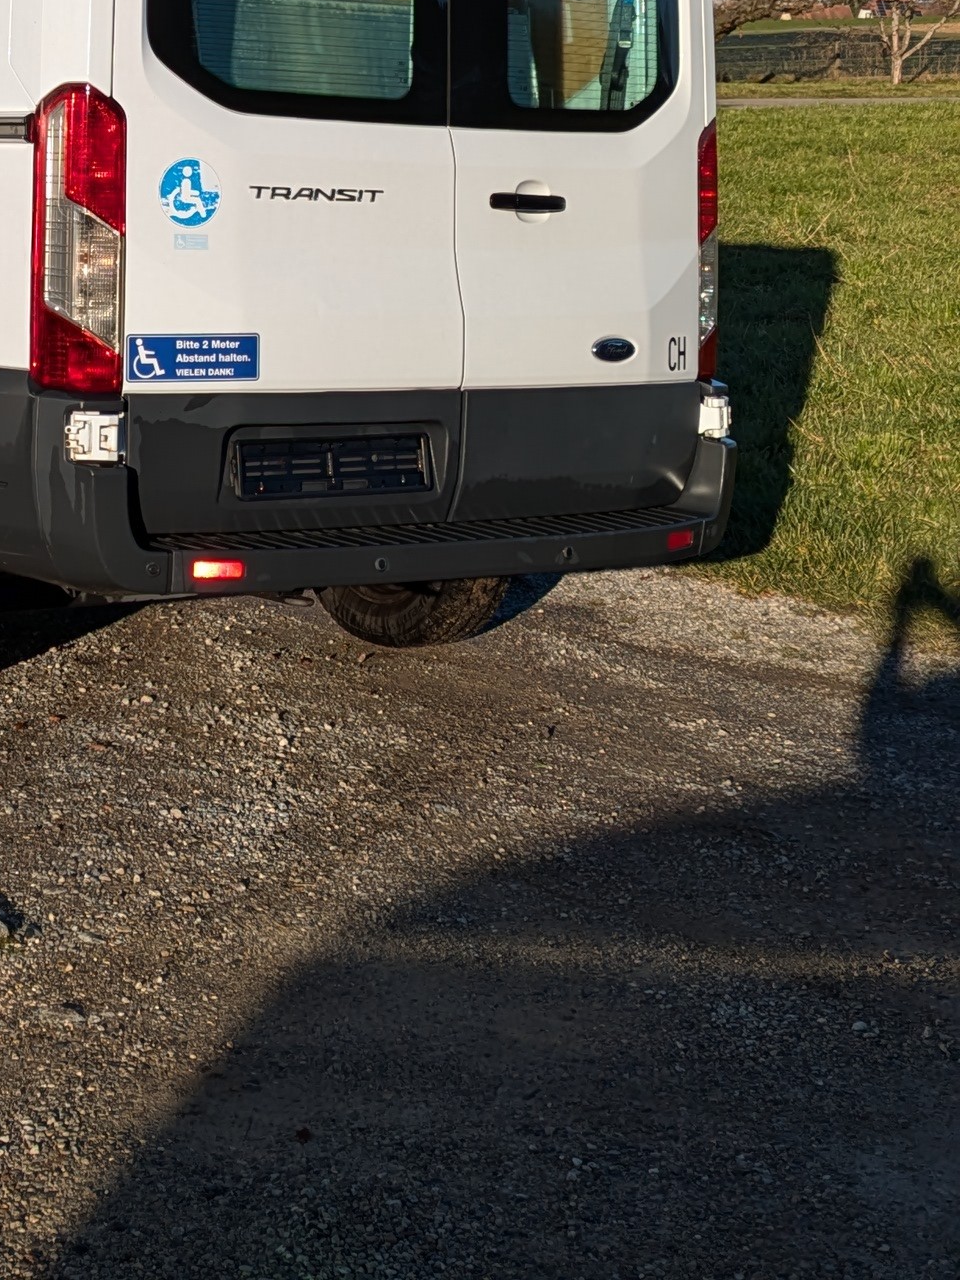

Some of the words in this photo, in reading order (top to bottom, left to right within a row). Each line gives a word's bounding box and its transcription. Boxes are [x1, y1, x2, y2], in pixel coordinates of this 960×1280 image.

[248, 185, 384, 203] TRANSIT
[175, 340, 200, 349] Bitte
[202, 340, 209, 349] 2
[211, 340, 240, 349] Meter
[175, 353, 216, 363] Abstand
[218, 353, 251, 362] halten.
[668, 336, 687, 371] CH
[175, 368, 206, 376] VIELEN
[208, 368, 235, 376] DANK!
